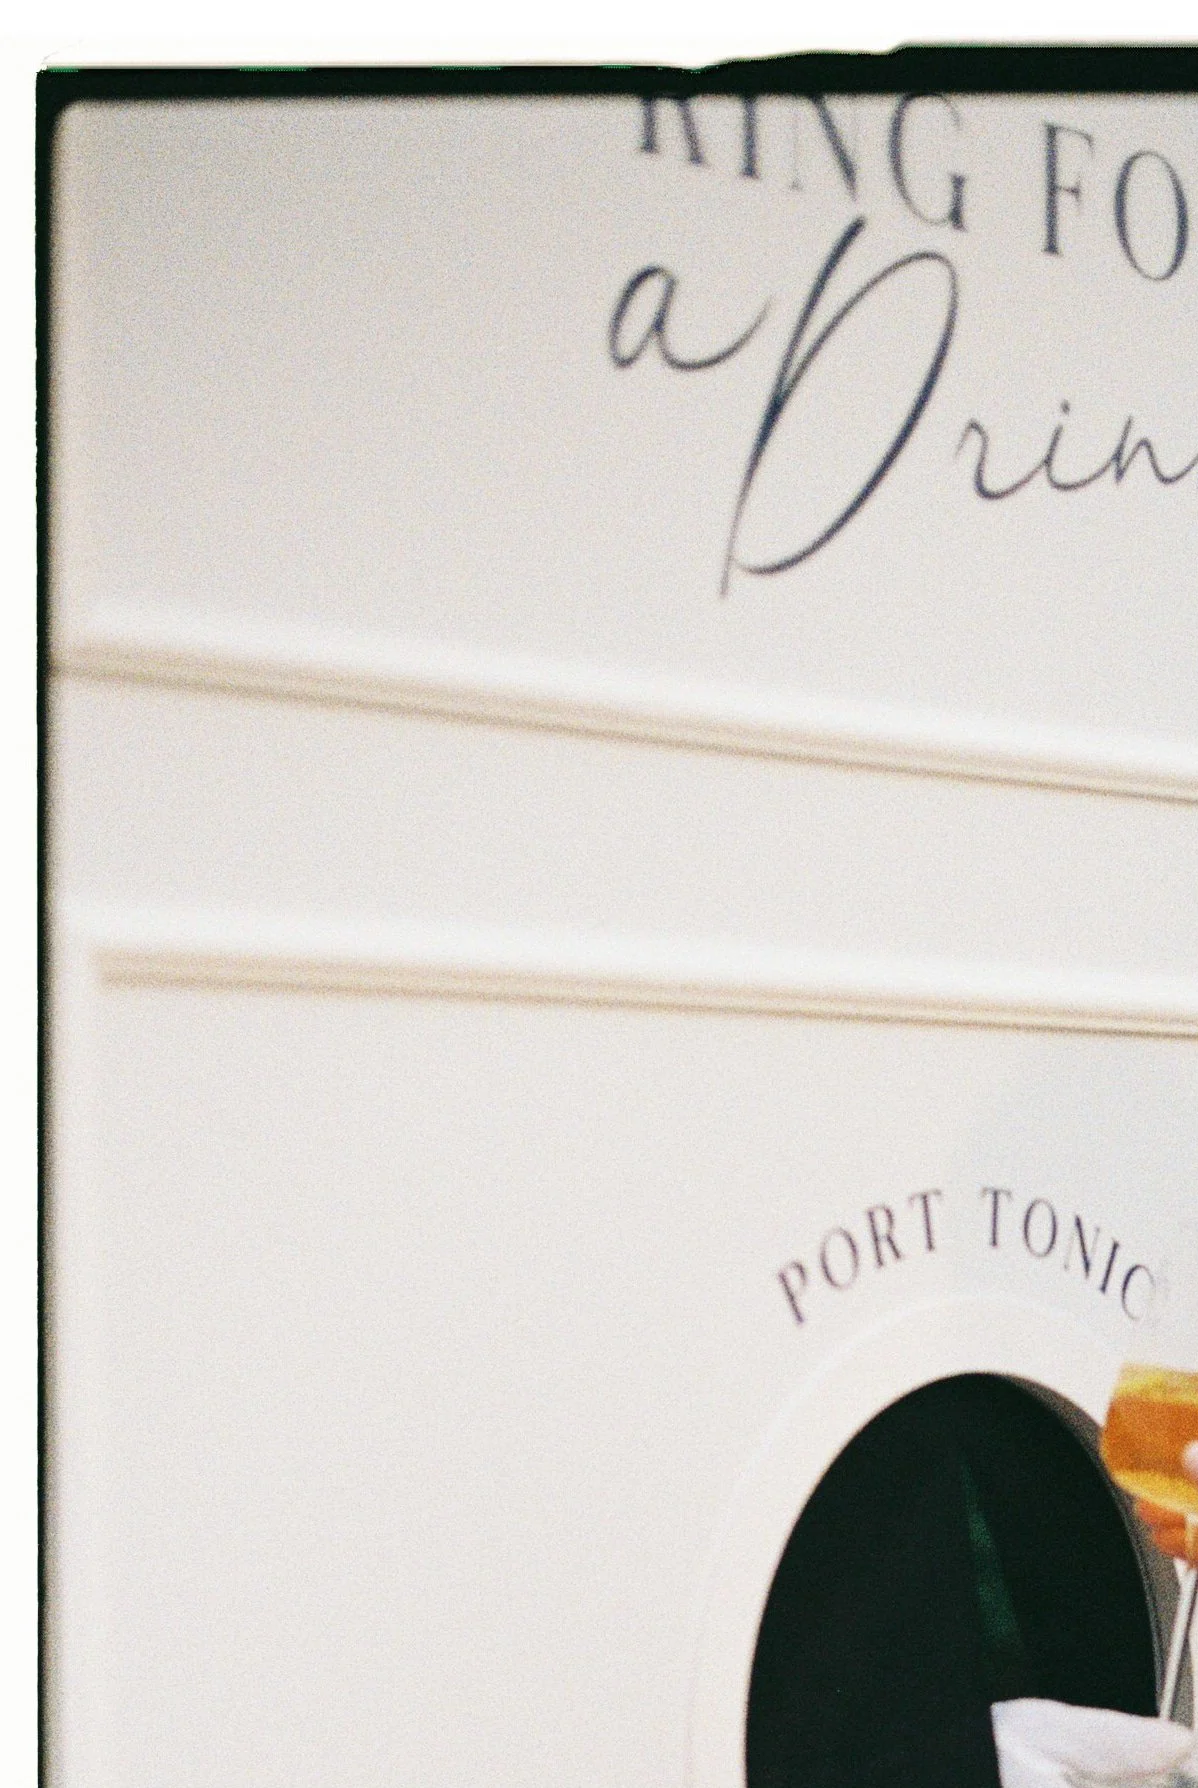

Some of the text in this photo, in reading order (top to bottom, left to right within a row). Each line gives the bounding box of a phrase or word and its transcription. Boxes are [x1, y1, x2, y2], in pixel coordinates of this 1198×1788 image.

[608, 265, 772, 371] a
[777, 1187, 1157, 1327] PORT TONIC
